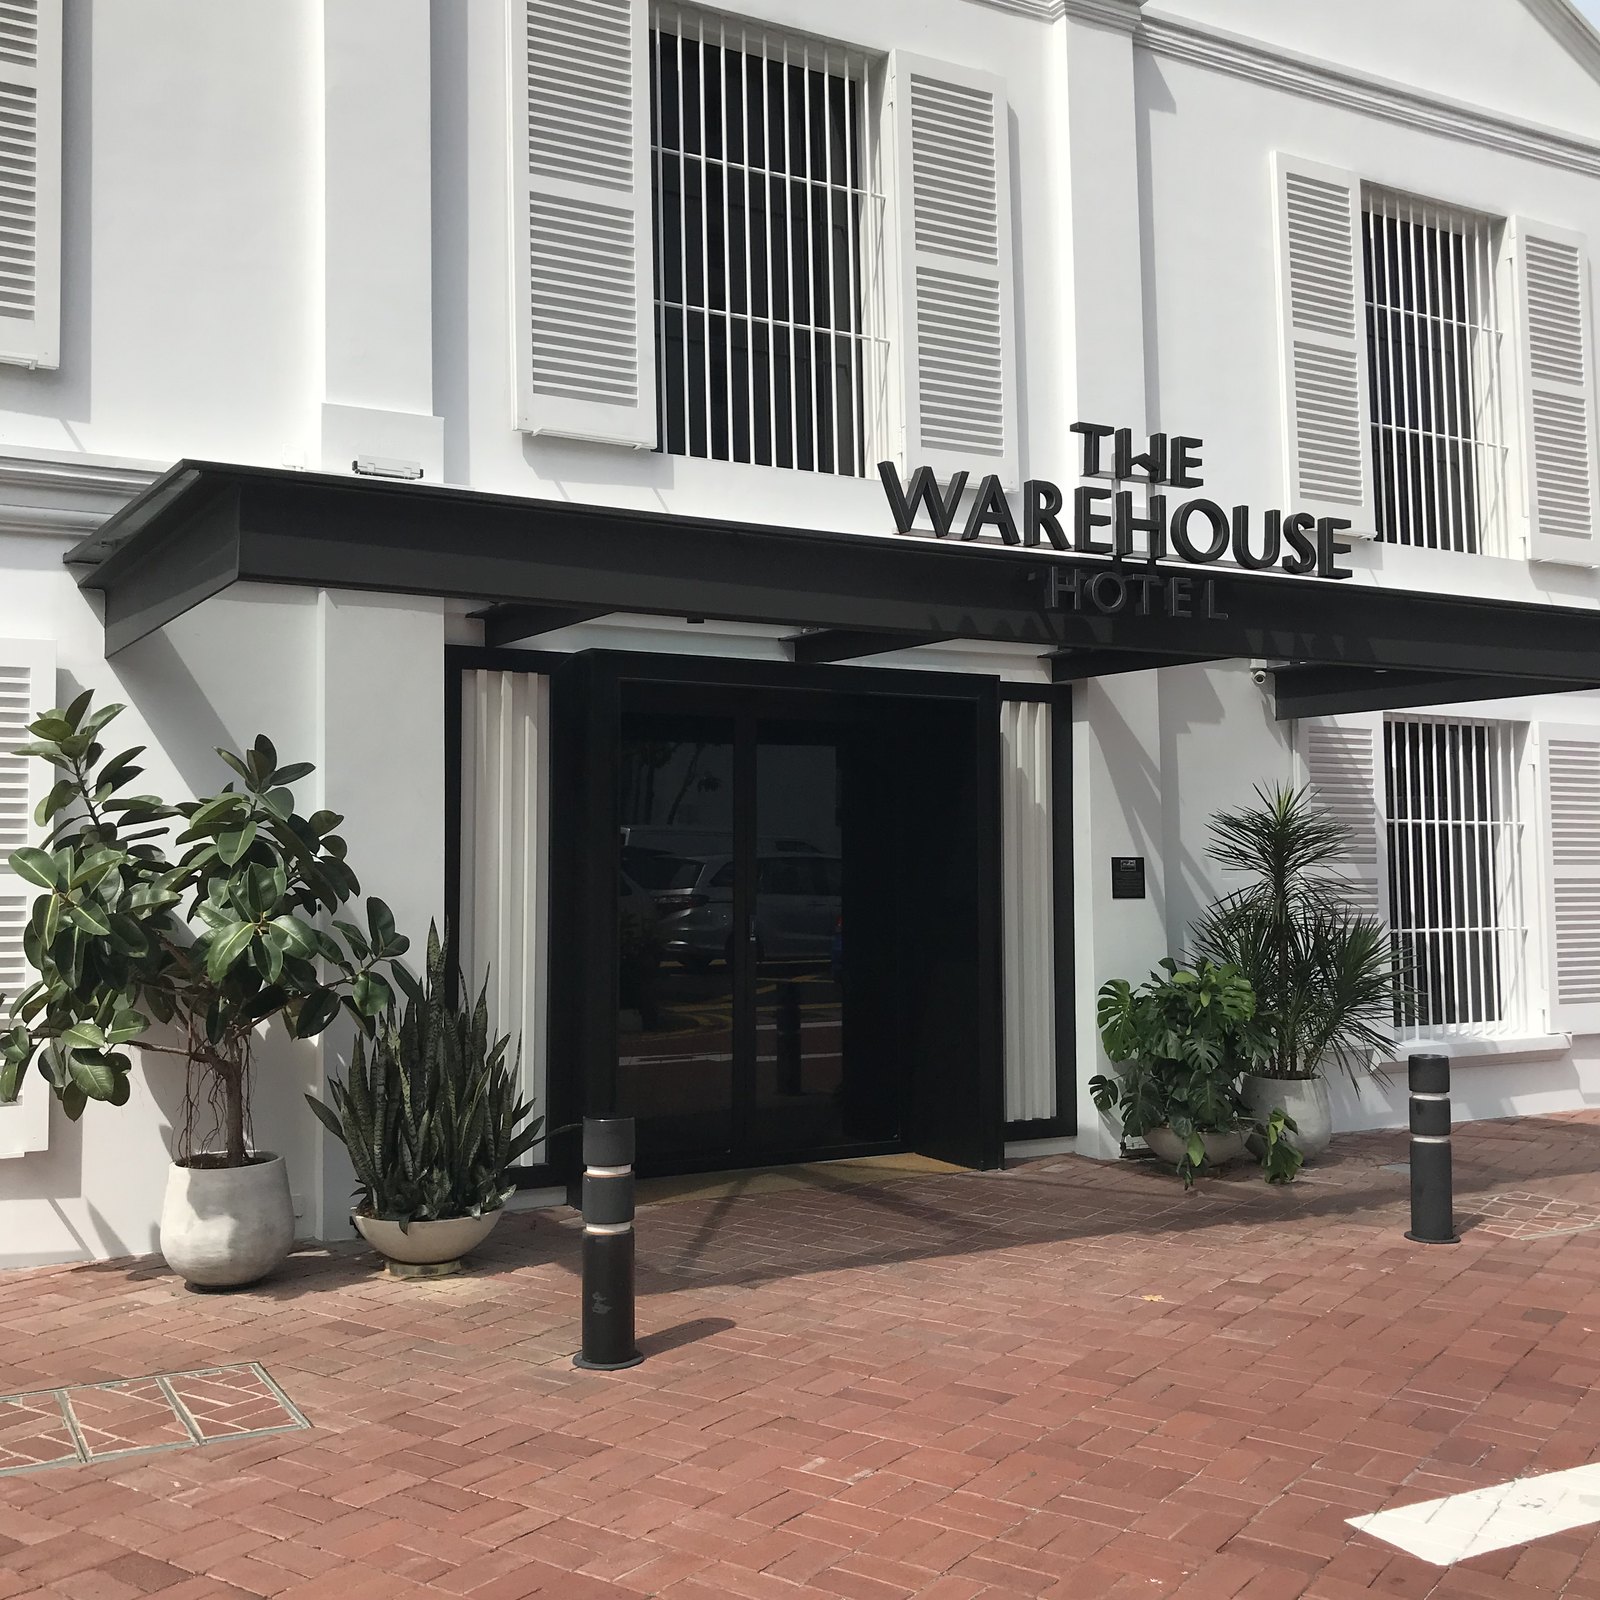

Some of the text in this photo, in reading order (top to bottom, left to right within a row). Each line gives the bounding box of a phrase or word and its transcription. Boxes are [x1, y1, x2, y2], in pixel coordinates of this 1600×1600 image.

[1070, 421, 1204, 489] THE
[877, 461, 1353, 579] WAREHOUSE
[1049, 565, 1229, 620] HOTEL
